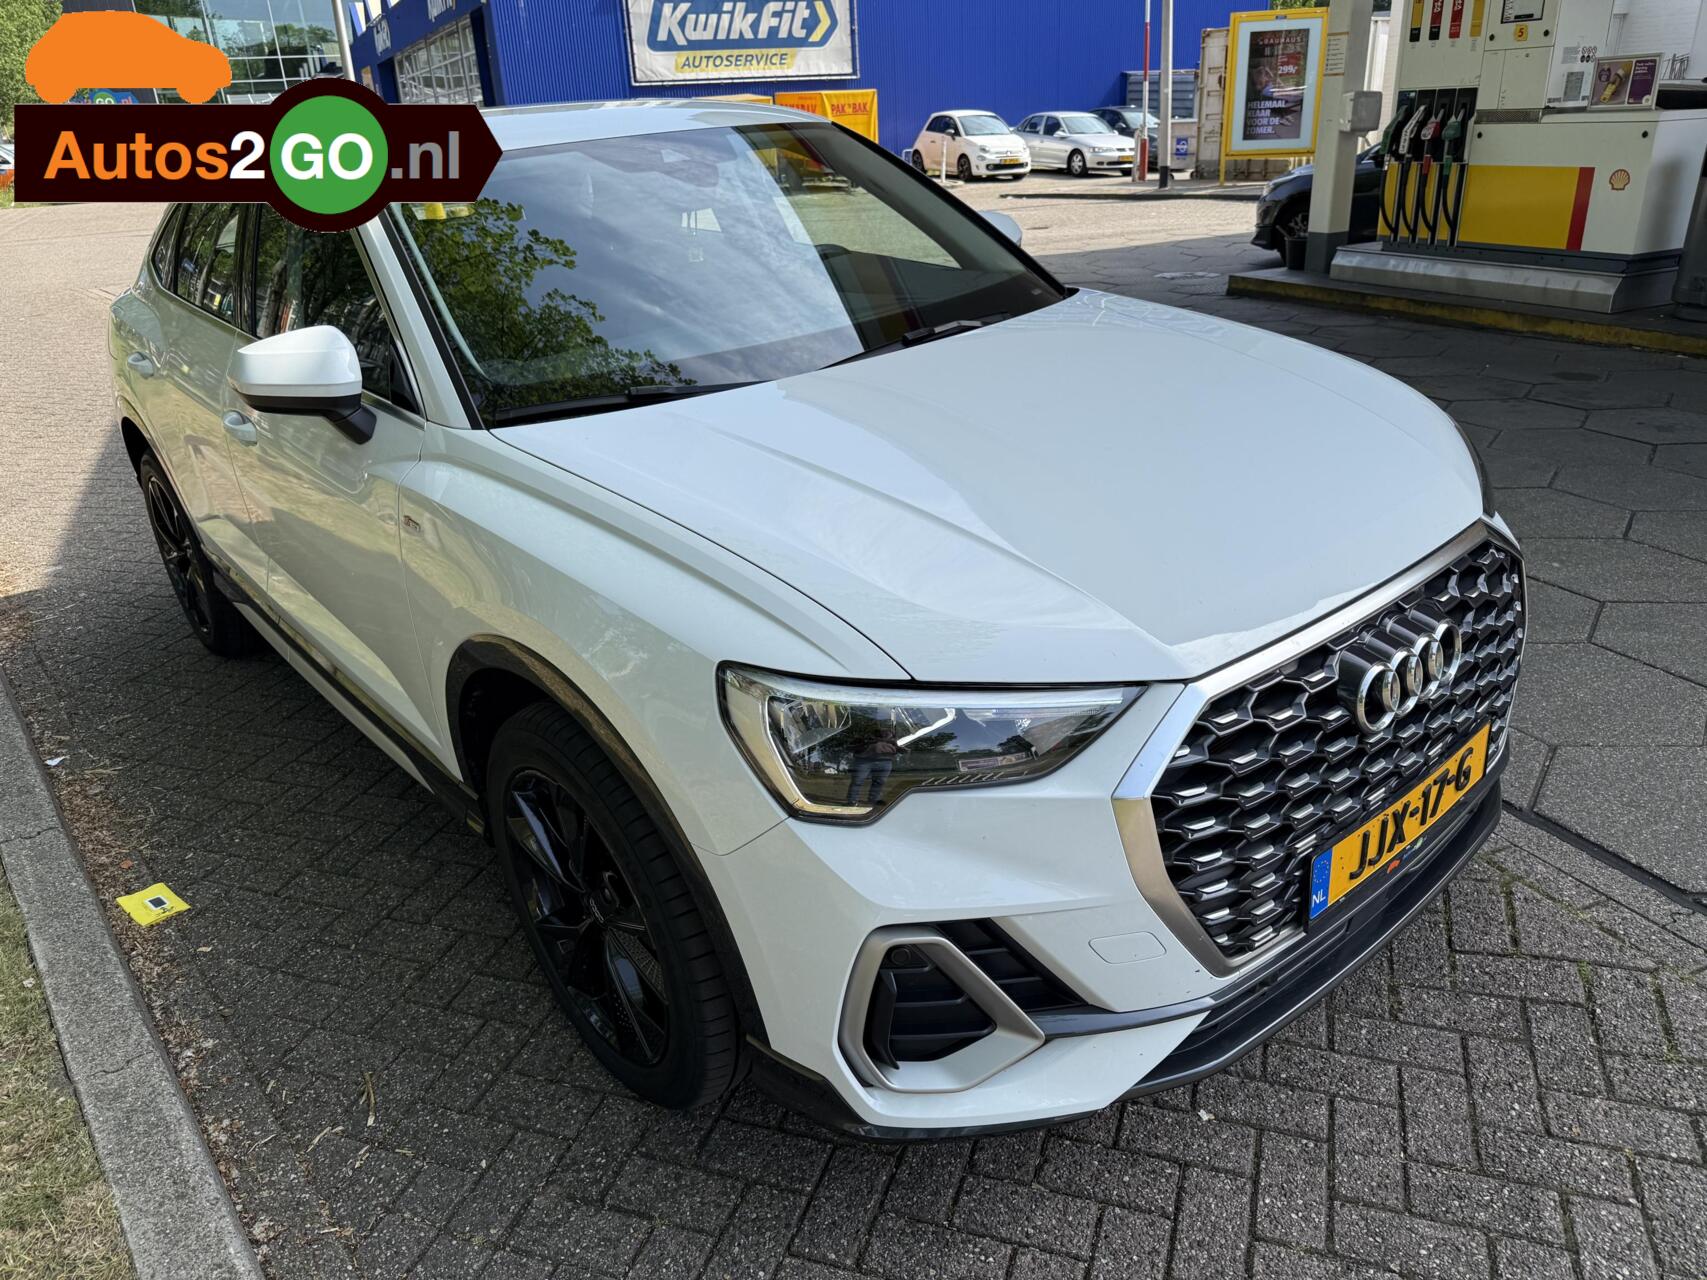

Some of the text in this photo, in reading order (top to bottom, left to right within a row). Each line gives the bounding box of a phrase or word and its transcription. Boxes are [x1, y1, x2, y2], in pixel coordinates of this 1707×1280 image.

[1517, 27, 1524, 37] 5
[681, 53, 788, 69] AUTOSERVICE
[1247, 100, 1286, 109] HELEMAAL
[1269, 117, 1280, 125] DE
[1349, 747, 1473, 880] JJX-17-G
[1312, 889, 1326, 907] NL
